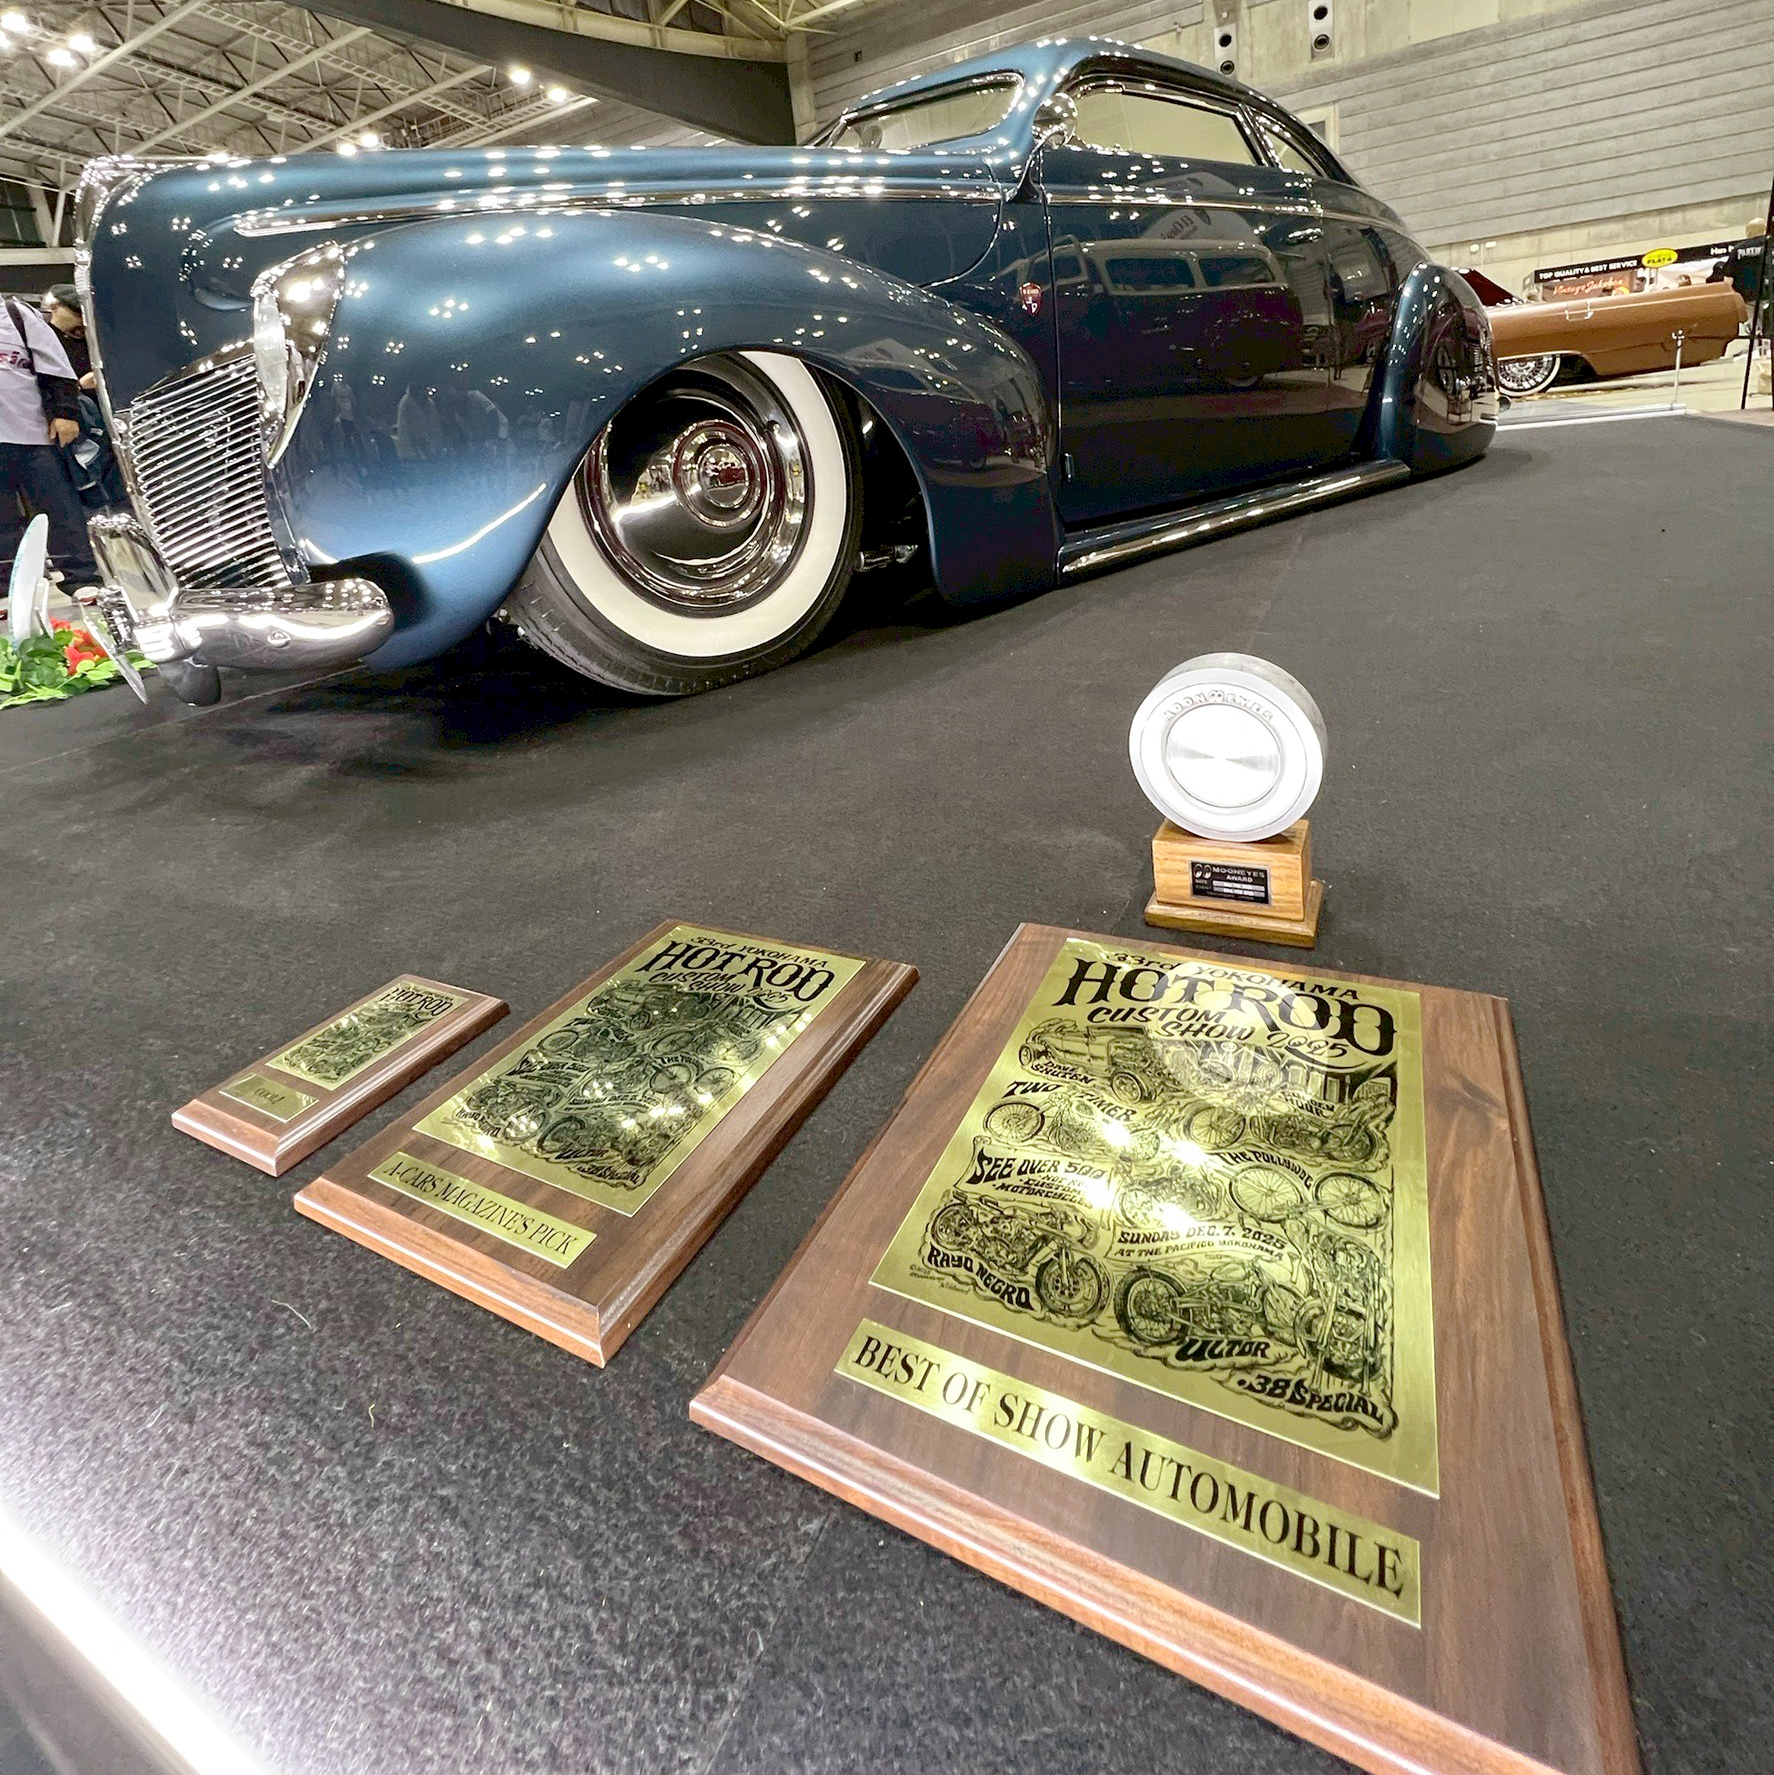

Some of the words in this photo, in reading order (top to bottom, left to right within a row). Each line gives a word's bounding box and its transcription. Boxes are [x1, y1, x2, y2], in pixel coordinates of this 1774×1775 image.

[1539, 272, 1553, 280] TOP
[1554, 268, 1585, 278] QUALITY
[1591, 264, 1607, 273] BEST
[1609, 260, 1638, 270] SERVICE
[1212, 866, 1265, 879] MOONEYES
[1226, 875, 1254, 883] AWARD
[739, 945, 827, 968] YOKOHAMA
[649, 971, 738, 984] CUSTOM
[688, 981, 748, 994] SHOW
[1195, 965, 1360, 1000] YOKOHAMA
[1087, 1006, 1227, 1024] CUSTOM
[1155, 1021, 1256, 1041] SHOW
[1265, 1030, 1350, 1058] 2025
[1002, 1081, 1064, 1099] TWO
[1076, 1092, 1137, 1122] TIMER
[966, 1147, 1017, 1185] SEE
[1016, 1158, 1060, 1176] OVER
[1063, 1161, 1108, 1179] 500
[1205, 1151, 1254, 1166] THE
[383, 1161, 439, 1194] A-CARS
[434, 1183, 535, 1236] MAGAZINE'S
[529, 1222, 578, 1255] PICK
[1114, 1249, 1135, 1257] AT
[1136, 1246, 1162, 1258] THE
[1165, 1241, 1215, 1254] PACIFICO
[1118, 1230, 1181, 1244] SUNDAY
[1241, 1226, 1288, 1250] 2025
[927, 1243, 974, 1273] RAYO
[975, 1261, 1036, 1311] NEGRO
[1175, 1338, 1271, 1362] ULTOR
[1236, 1374, 1291, 1399] .38
[1287, 1377, 1384, 1427] SPECIAL
[852, 1335, 941, 1393] BEST
[942, 1372, 991, 1414] OF
[993, 1392, 1106, 1463] SHOW
[1107, 1439, 1404, 1600] AUTOMOBILE
